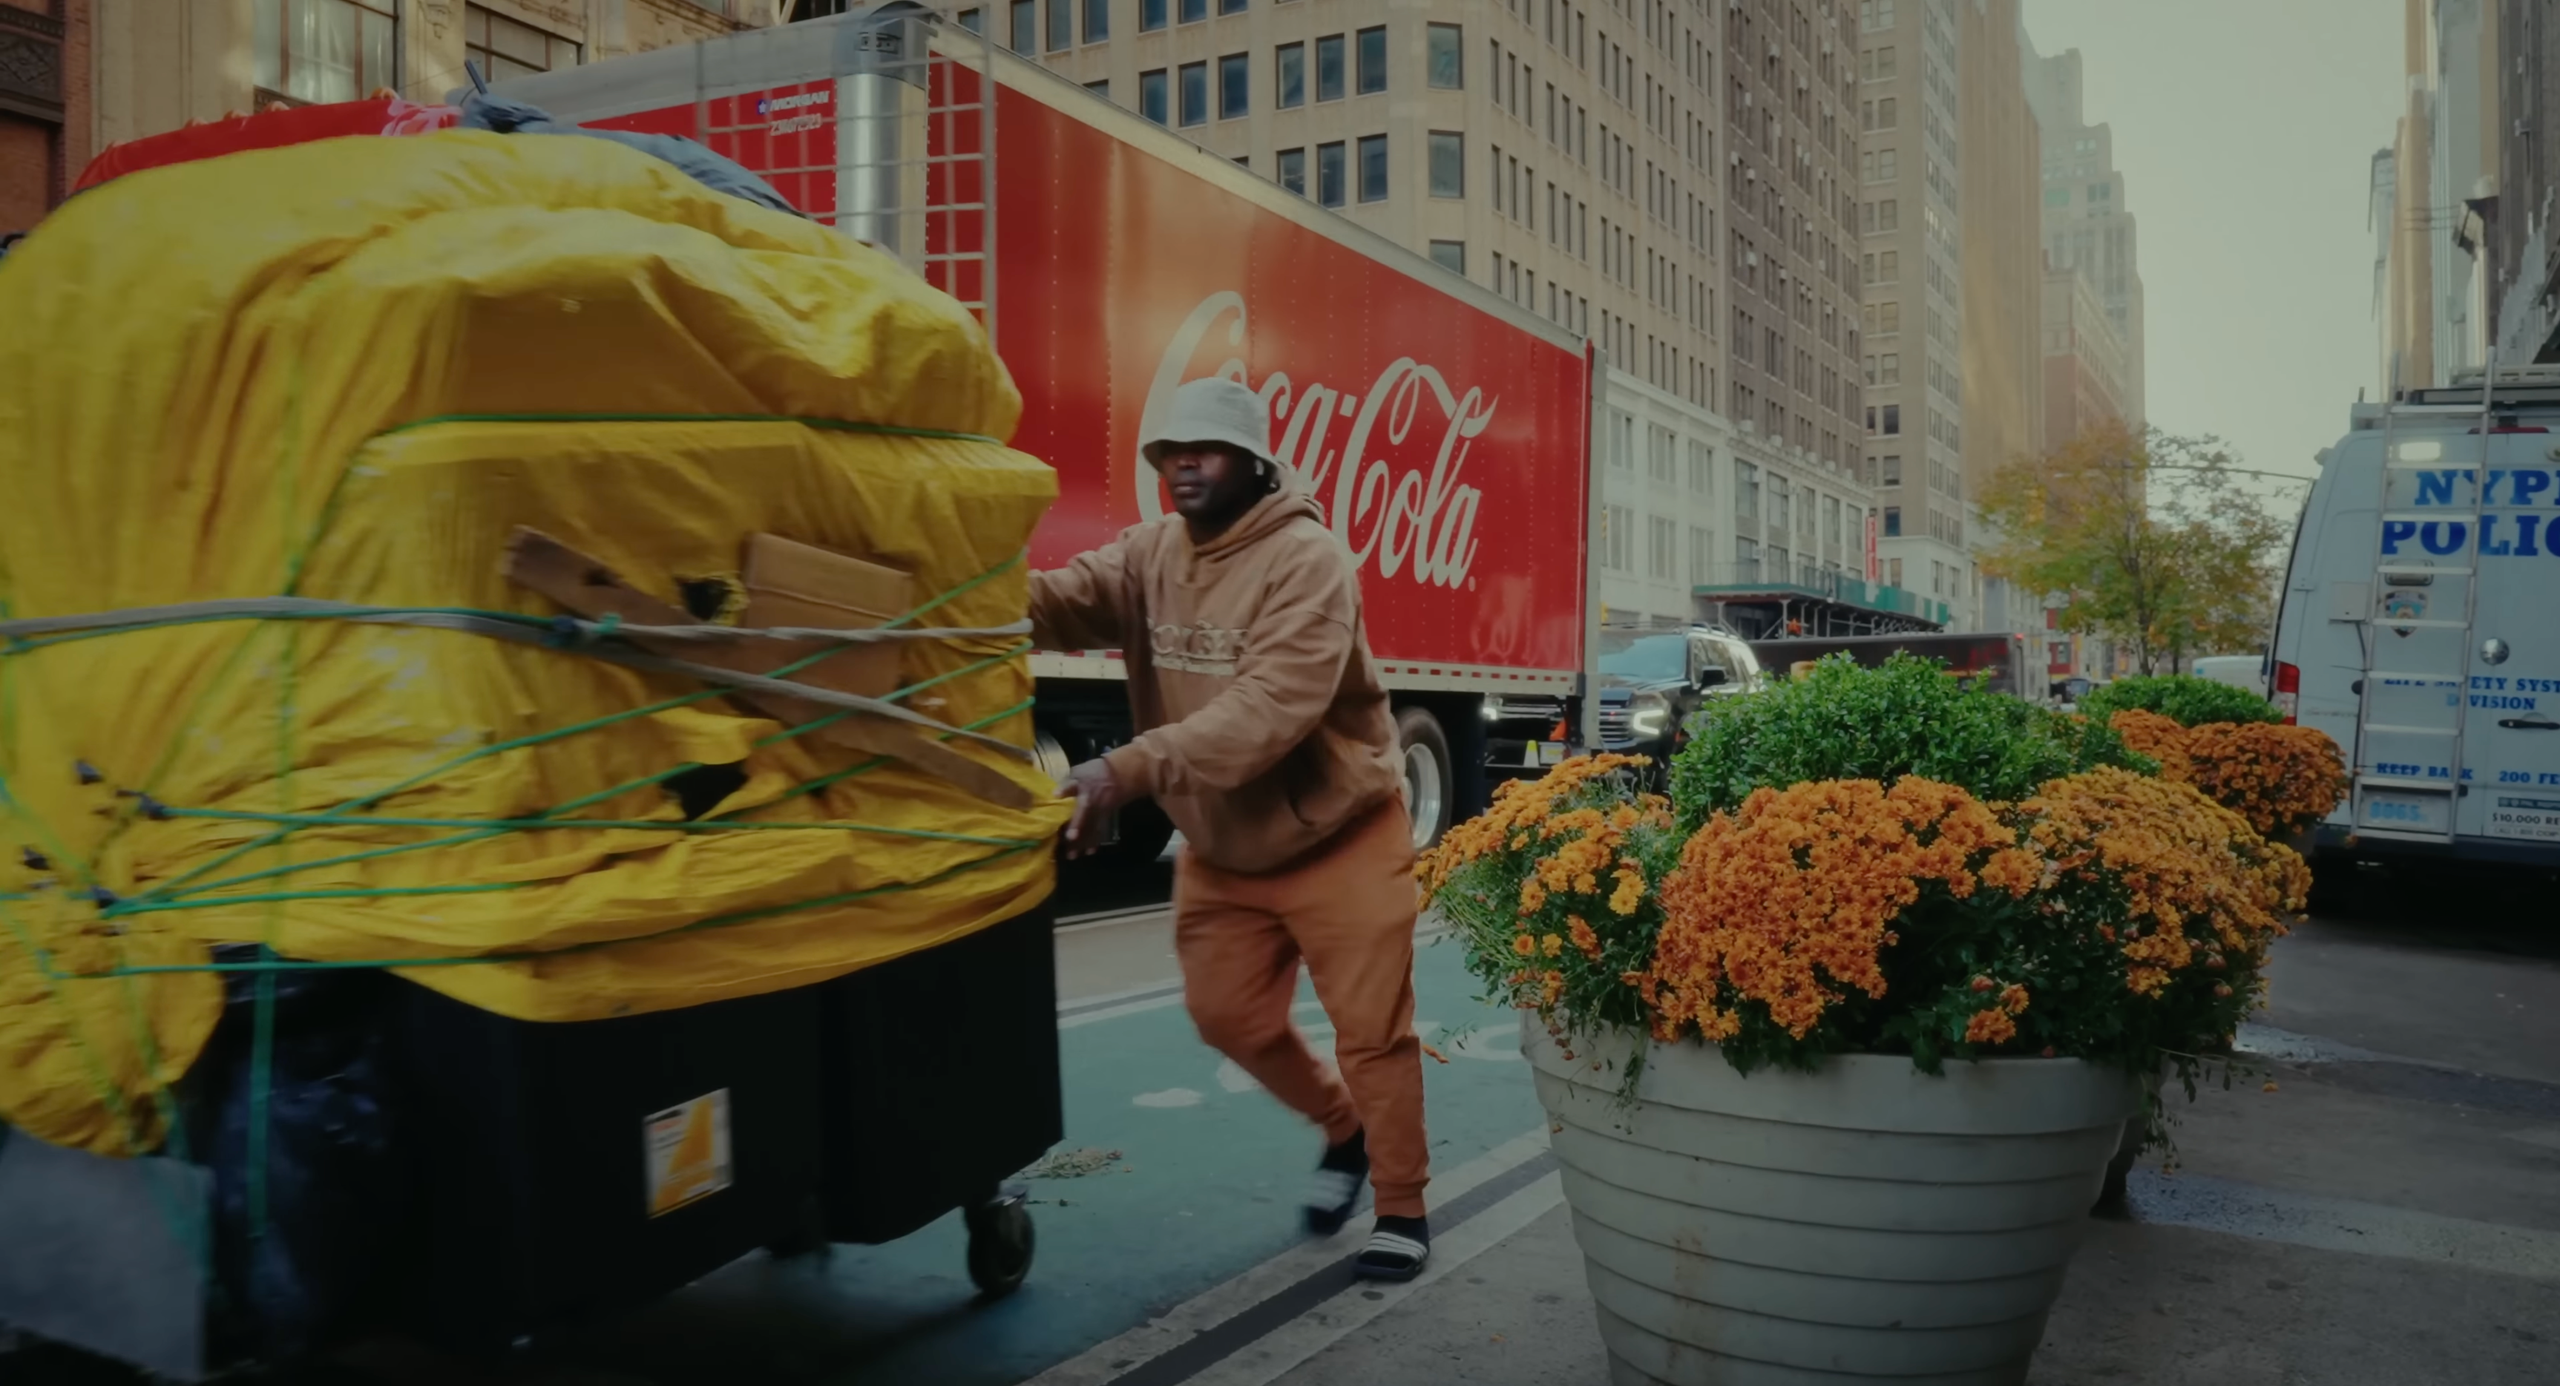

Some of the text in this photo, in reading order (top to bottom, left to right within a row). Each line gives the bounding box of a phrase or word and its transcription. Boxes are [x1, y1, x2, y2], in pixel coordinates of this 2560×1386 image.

[2414, 469, 2560, 506] NYP
[2446, 693, 2535, 710] DVISION
[2377, 762, 2421, 776] KEEP
[2428, 765, 2473, 780] BAK
[2499, 770, 2531, 783] 200
